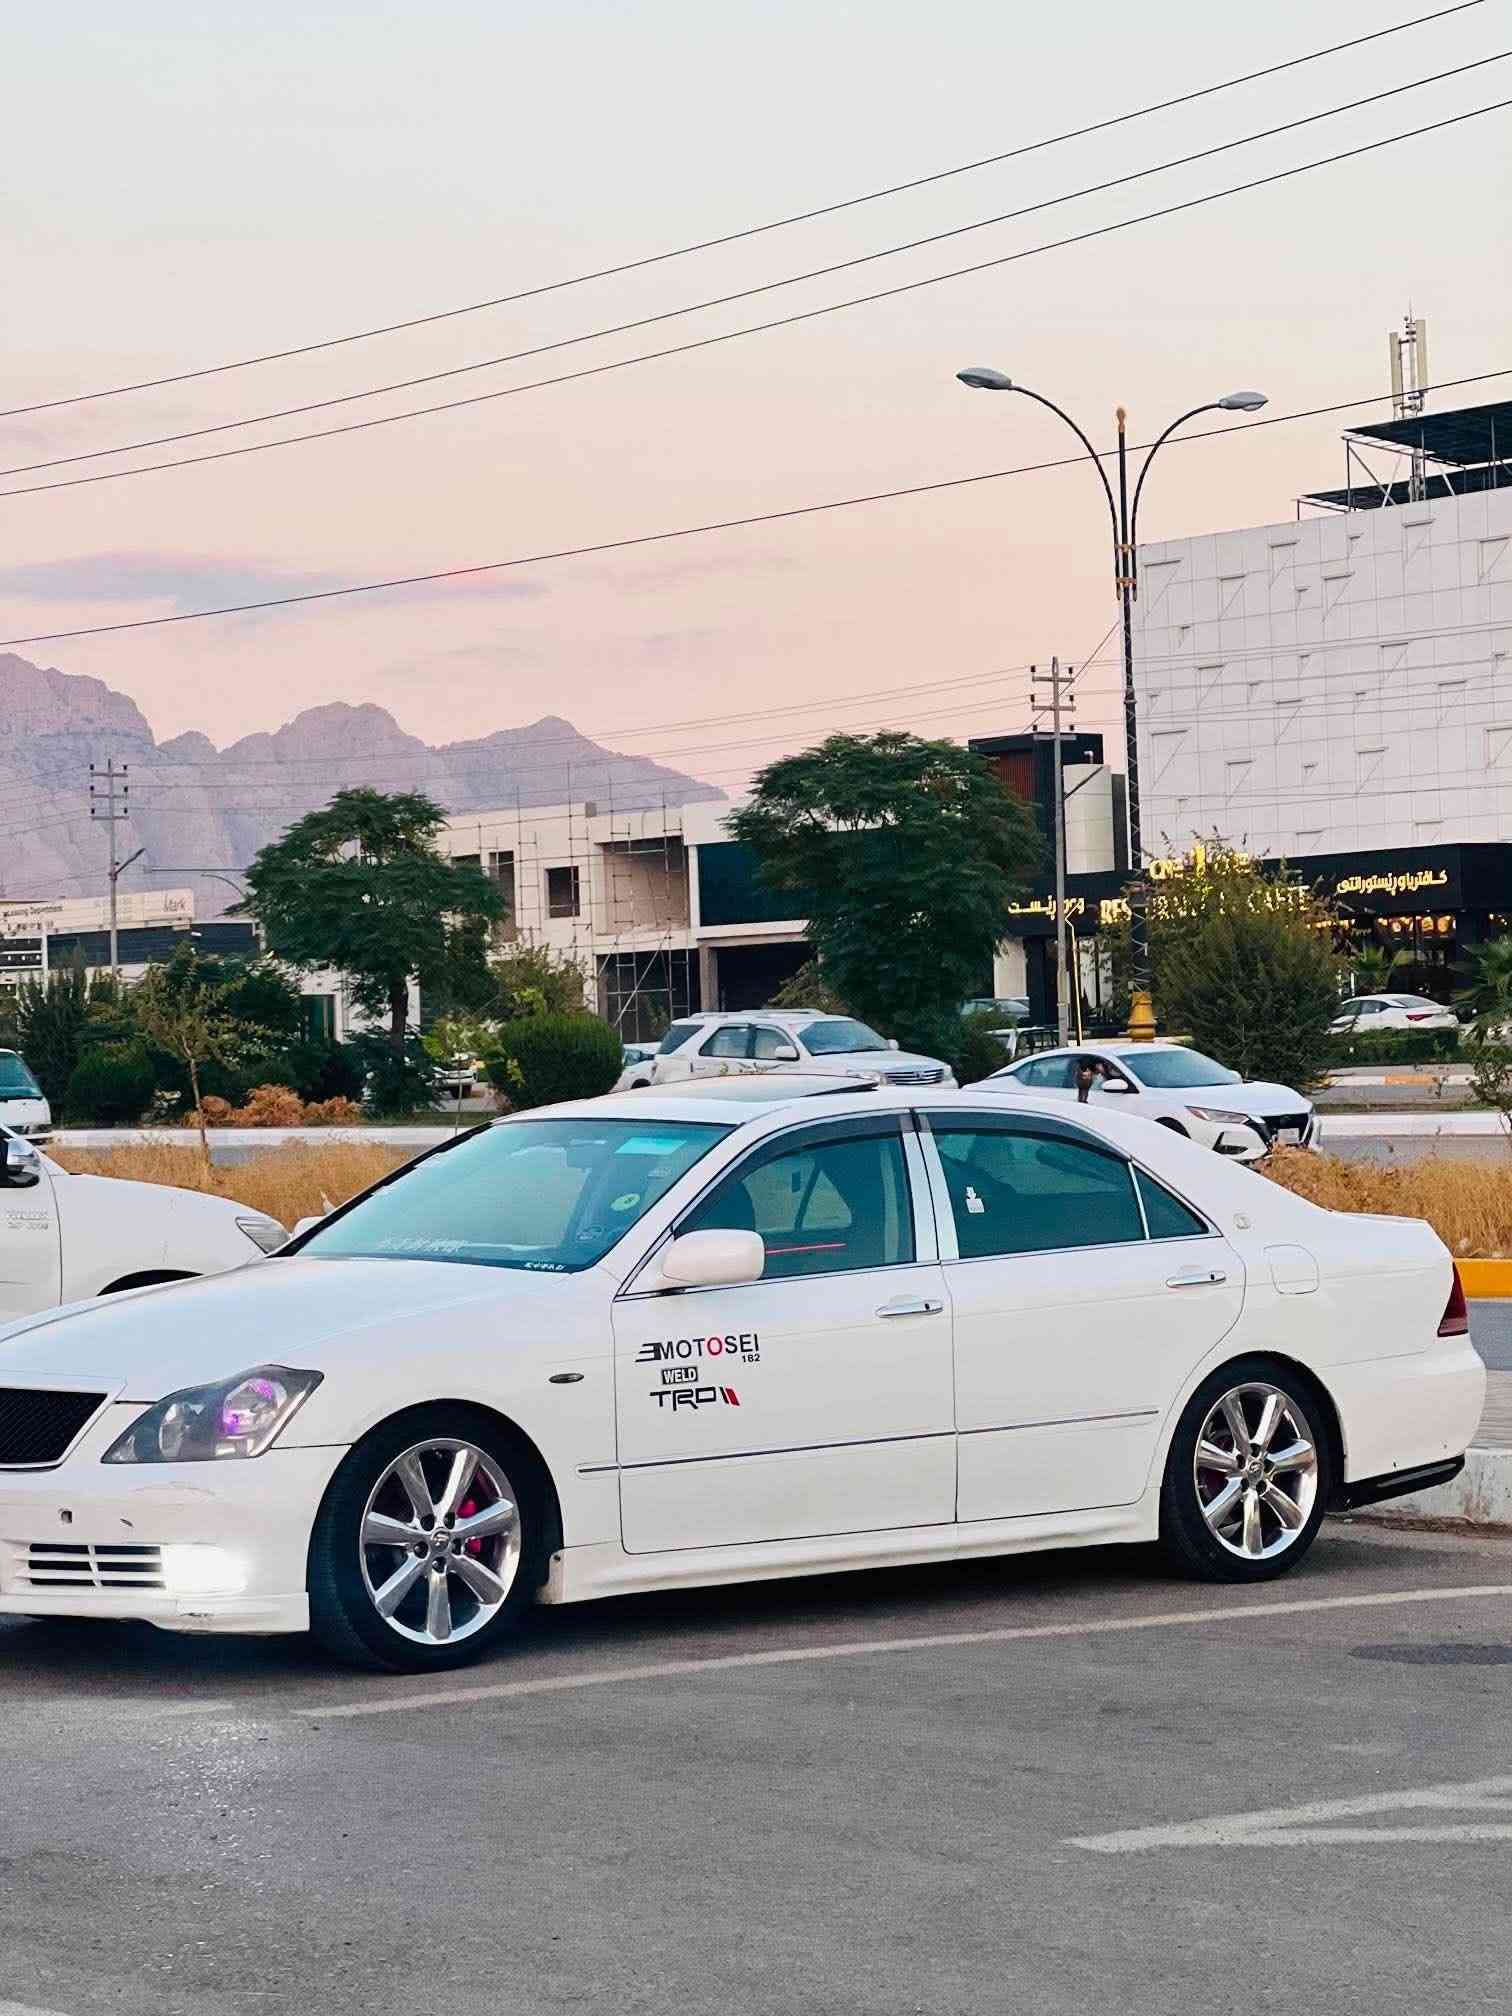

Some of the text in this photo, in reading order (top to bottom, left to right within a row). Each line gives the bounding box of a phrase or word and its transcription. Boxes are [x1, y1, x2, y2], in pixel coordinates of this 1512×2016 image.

[742, 1353, 761, 1363] 182
[663, 1367, 697, 1384] WELD
[649, 1386, 717, 1412] TRD
